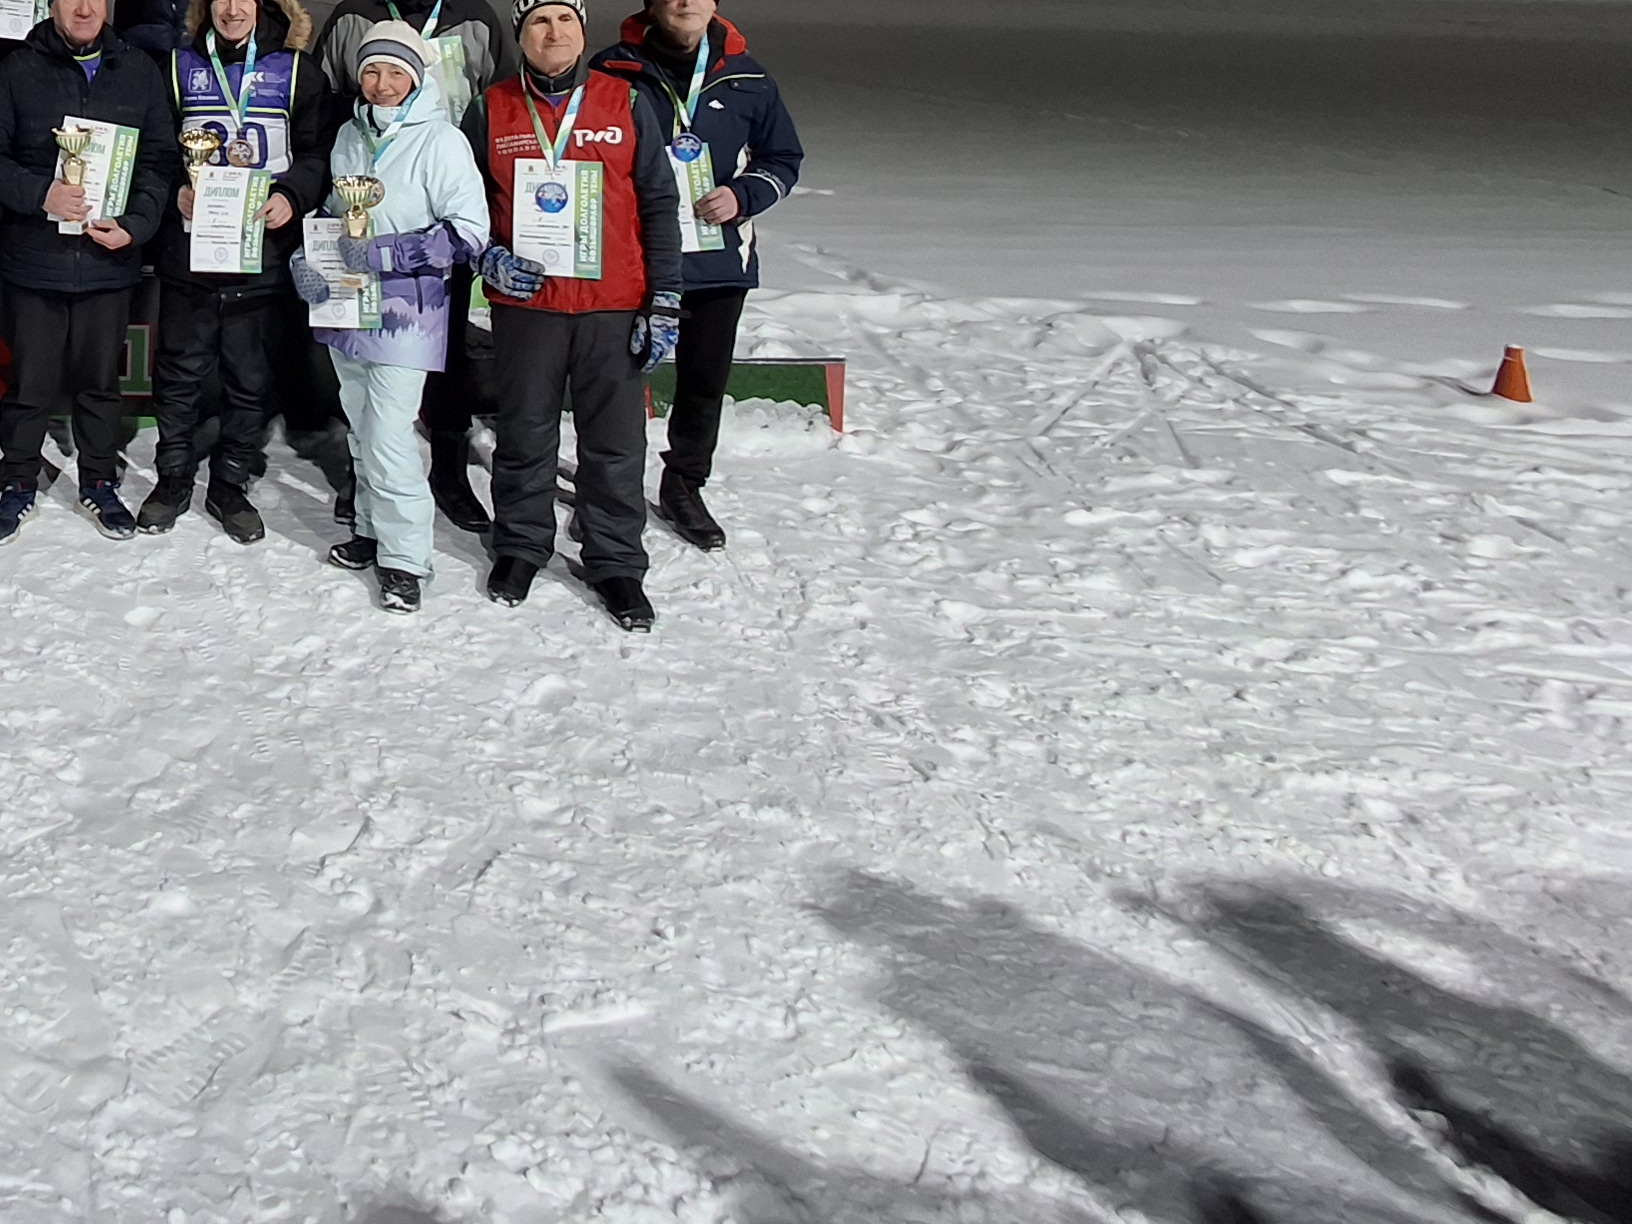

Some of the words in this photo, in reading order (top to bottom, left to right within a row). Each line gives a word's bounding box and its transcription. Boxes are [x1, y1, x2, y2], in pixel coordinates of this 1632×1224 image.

[203, 186, 240, 197] ДИПЛОМ
[579, 170, 589, 233] ДОЛГОЛЕТИЯ
[579, 235, 588, 262] ИГРЫ
[118, 325, 153, 396] 1
